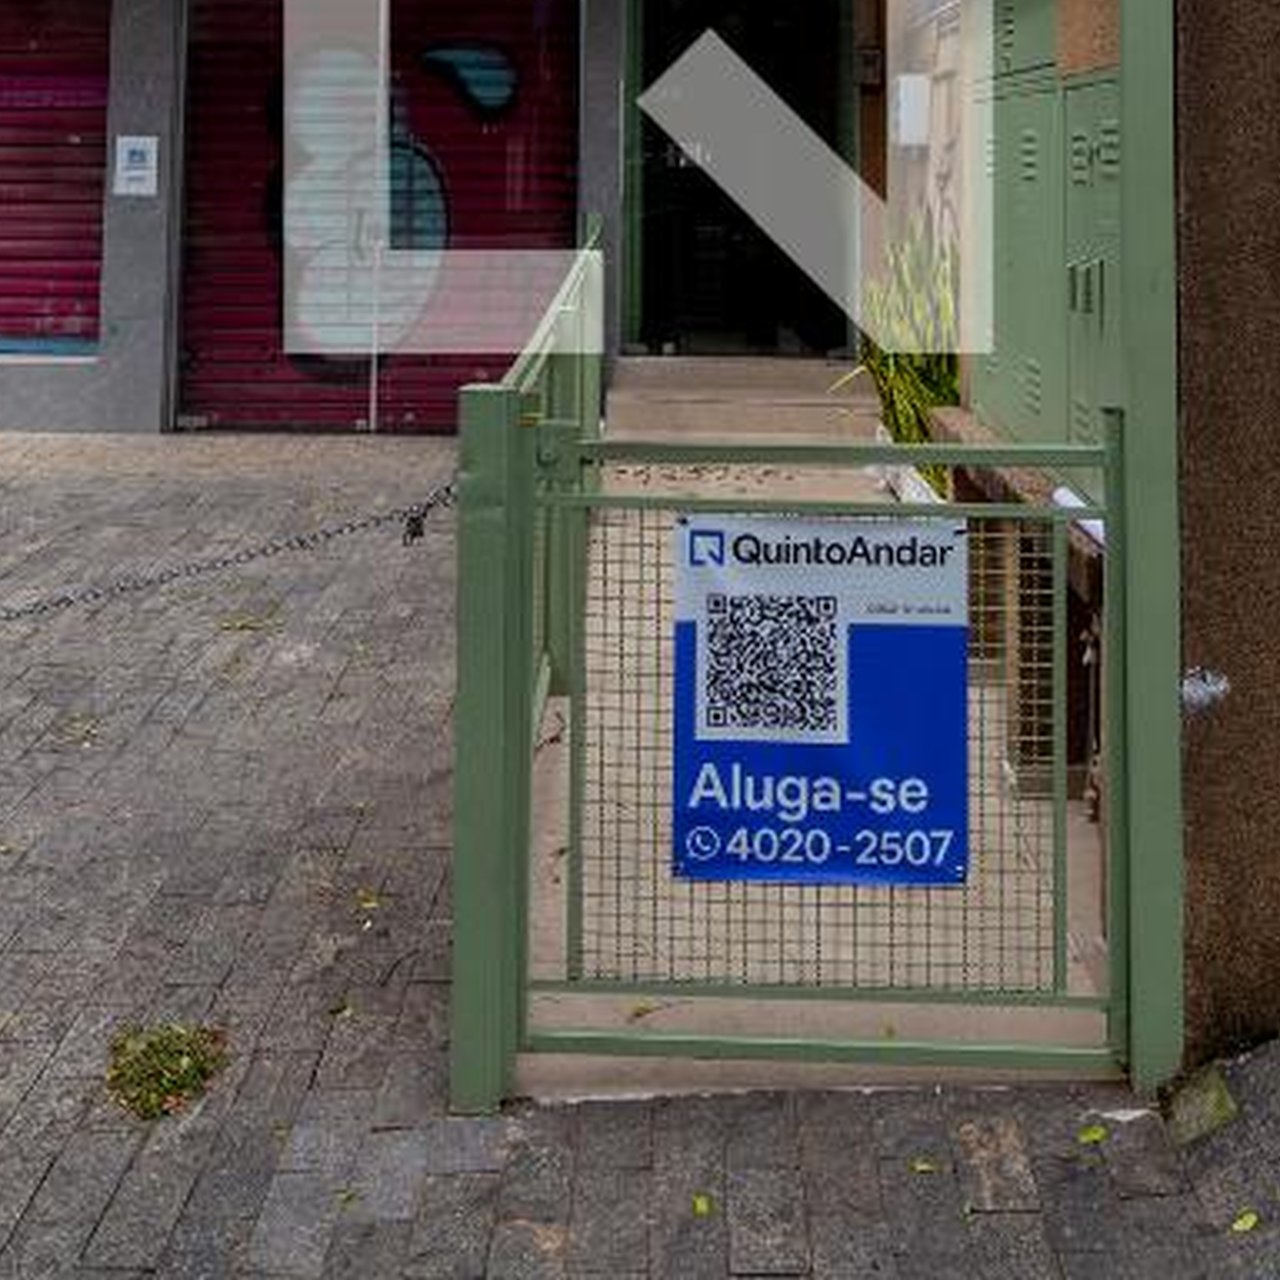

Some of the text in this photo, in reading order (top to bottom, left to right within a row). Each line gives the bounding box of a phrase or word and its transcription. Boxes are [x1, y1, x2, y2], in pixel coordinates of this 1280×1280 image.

[732, 534, 954, 568] QuintoAndar
[688, 762, 929, 821] Aluga-se
[726, 828, 954, 865] 4020-2507
